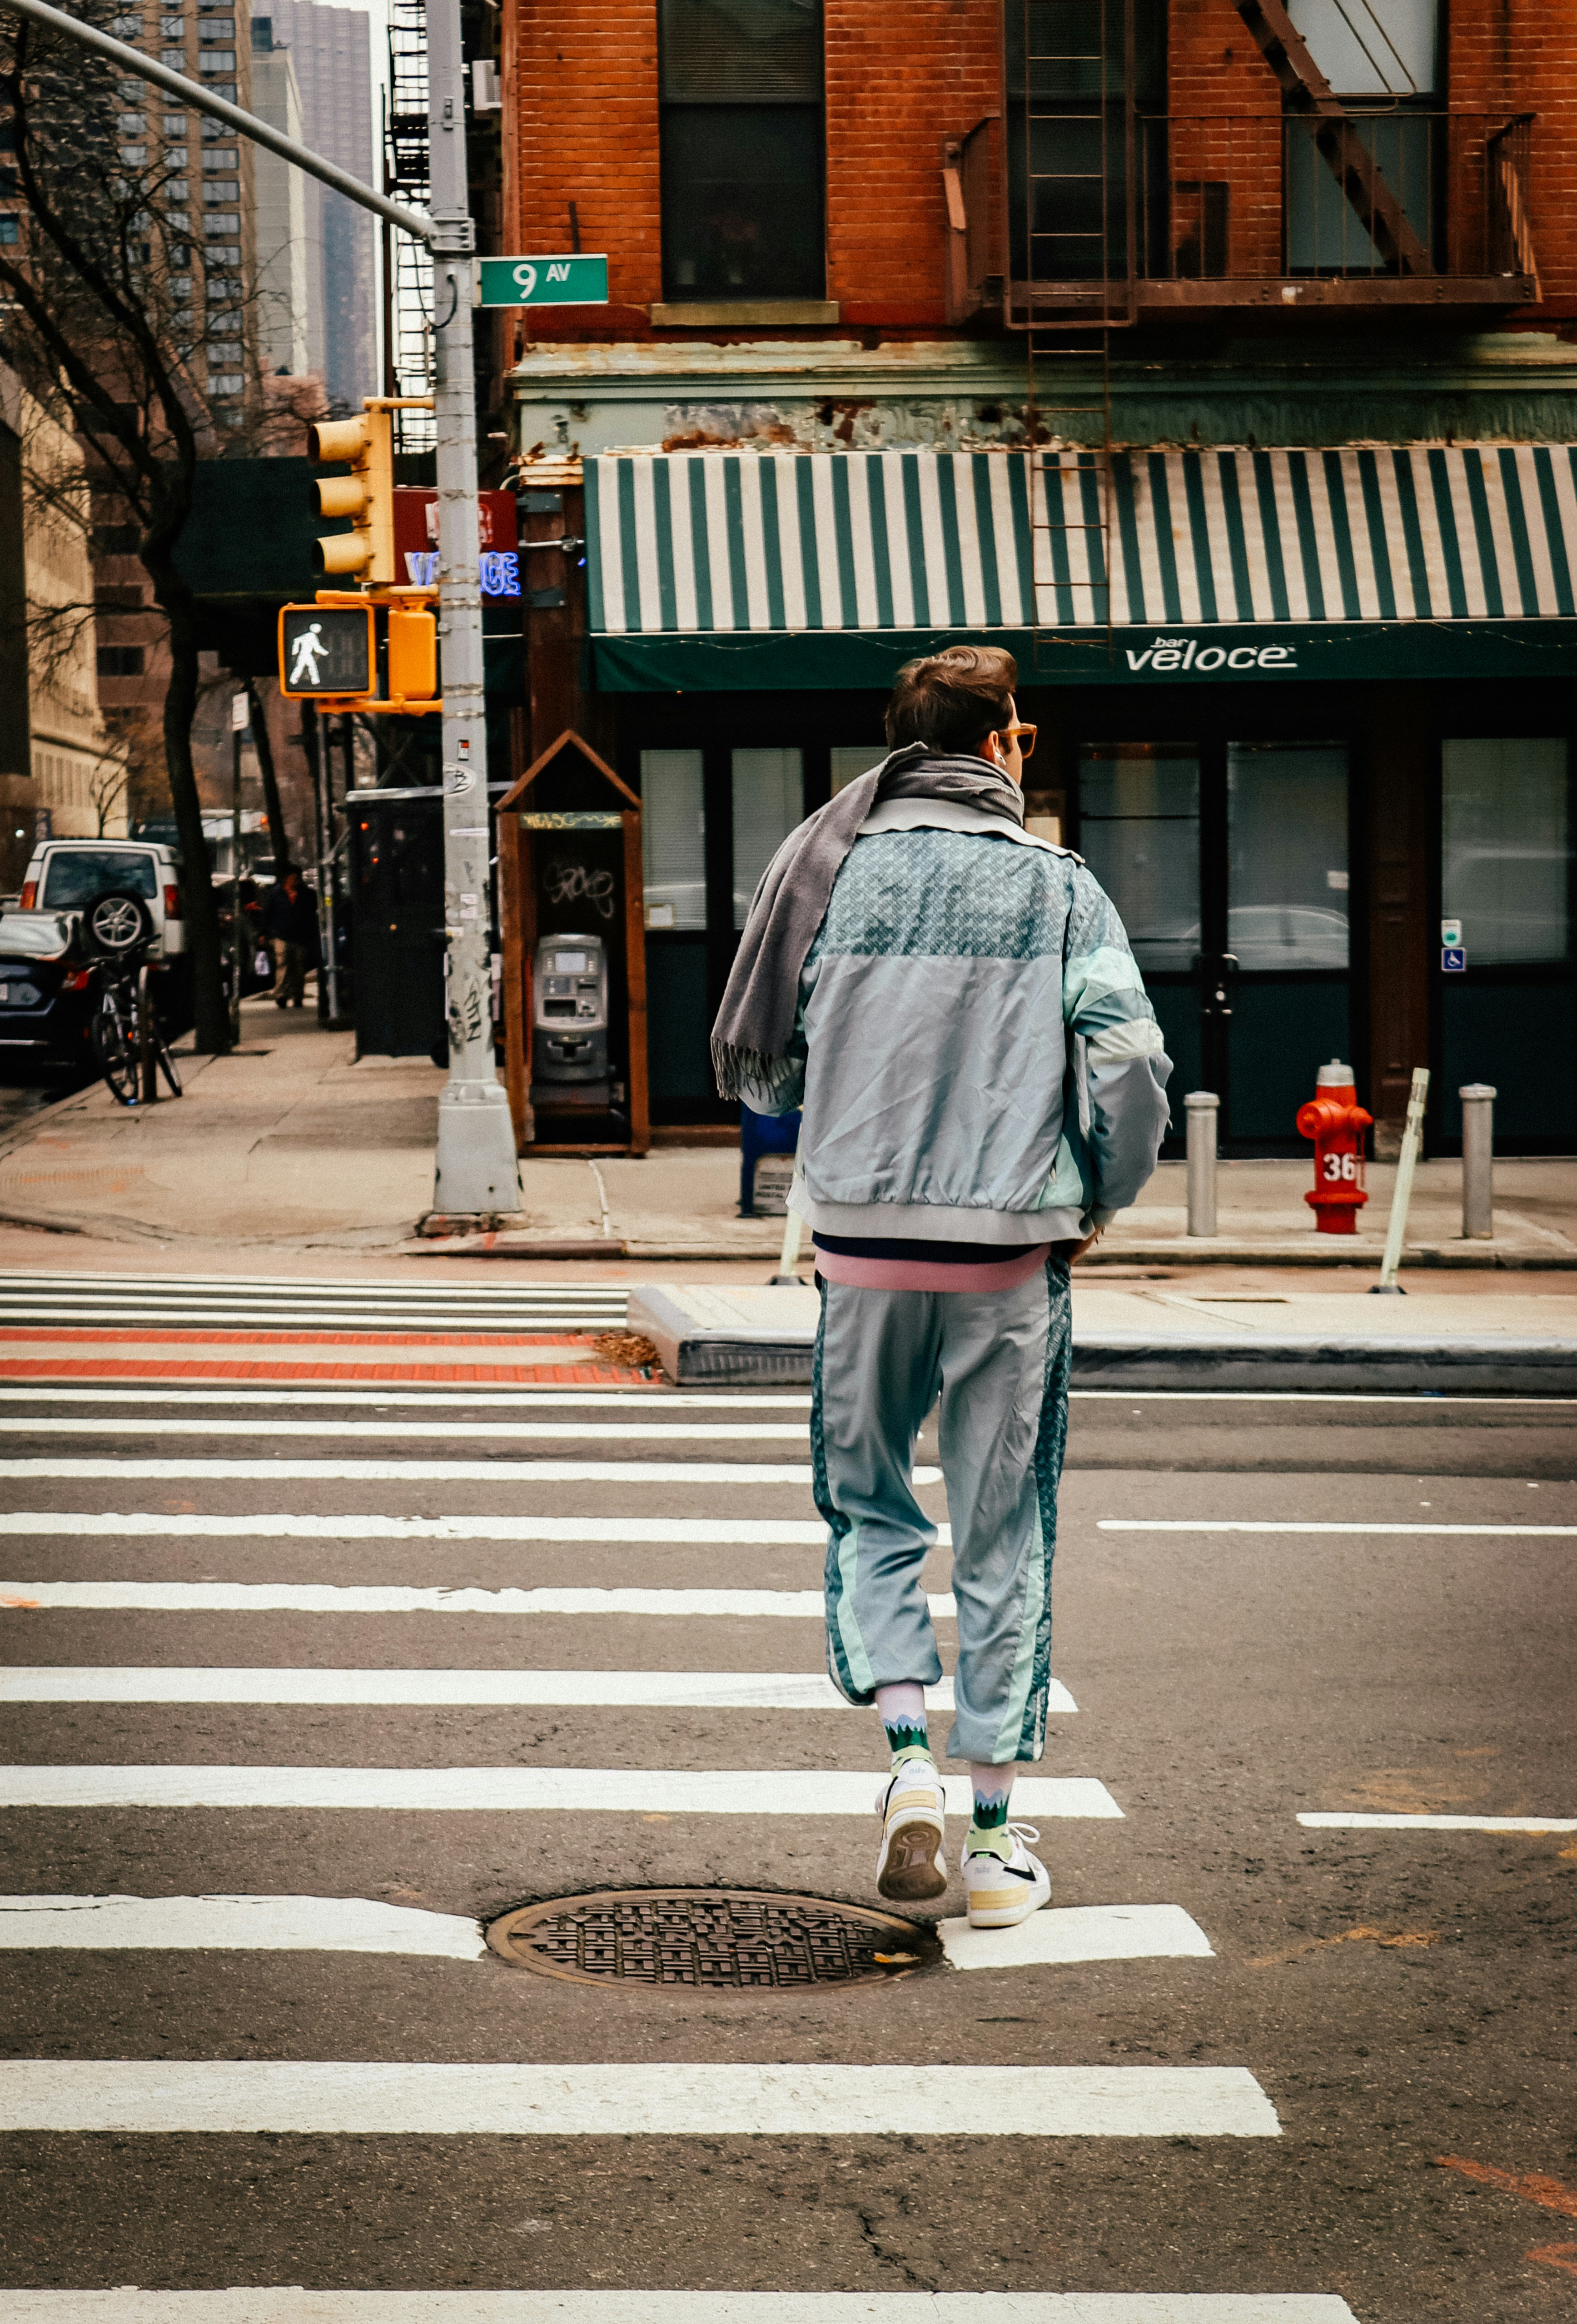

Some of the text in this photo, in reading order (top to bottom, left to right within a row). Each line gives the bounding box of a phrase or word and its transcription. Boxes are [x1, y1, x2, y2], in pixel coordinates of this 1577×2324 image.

[512, 263, 571, 299] 9 AV
[1125, 640, 1298, 671] veloce
[1150, 637, 1189, 649] bar
[1323, 1153, 1355, 1181] 36
